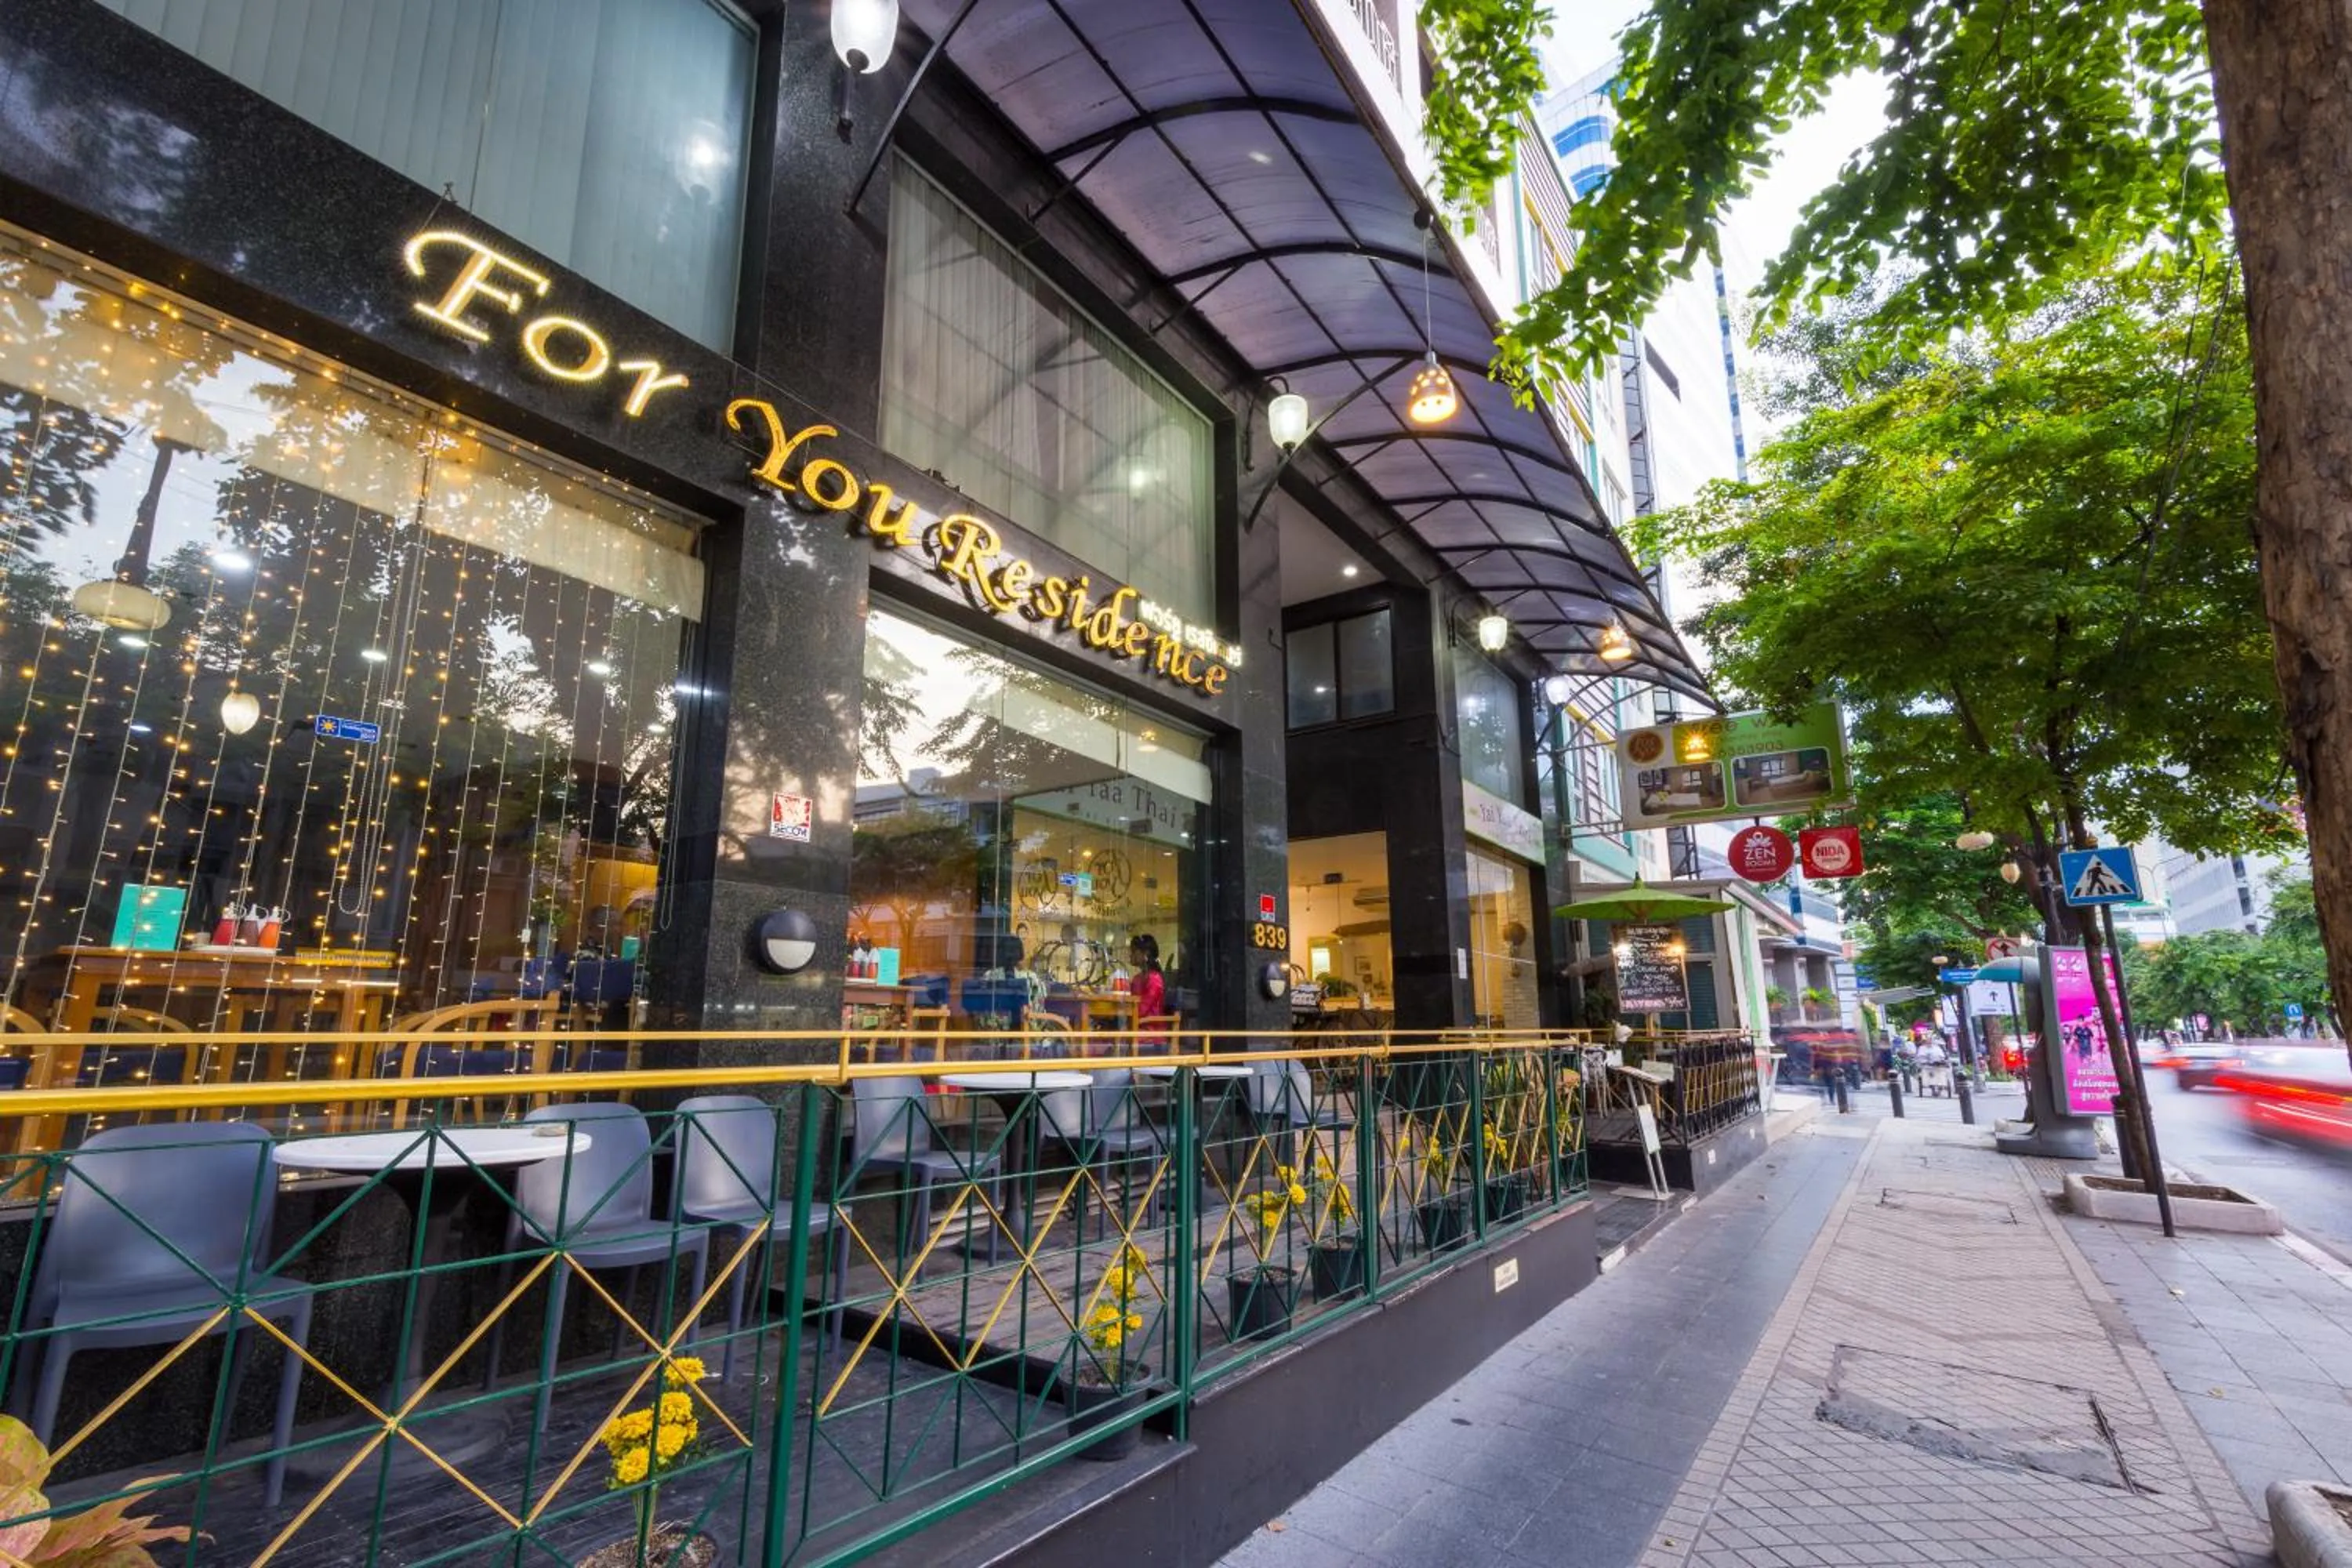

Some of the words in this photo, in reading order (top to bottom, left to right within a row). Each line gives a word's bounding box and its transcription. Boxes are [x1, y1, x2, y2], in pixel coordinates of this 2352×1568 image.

[403, 230, 688, 417] For
[725, 397, 918, 547] You
[940, 513, 1229, 696] Residence
[1131, 786, 1177, 829] Thai
[1744, 846, 1776, 860] ZEN
[1254, 923, 1287, 950] 839
